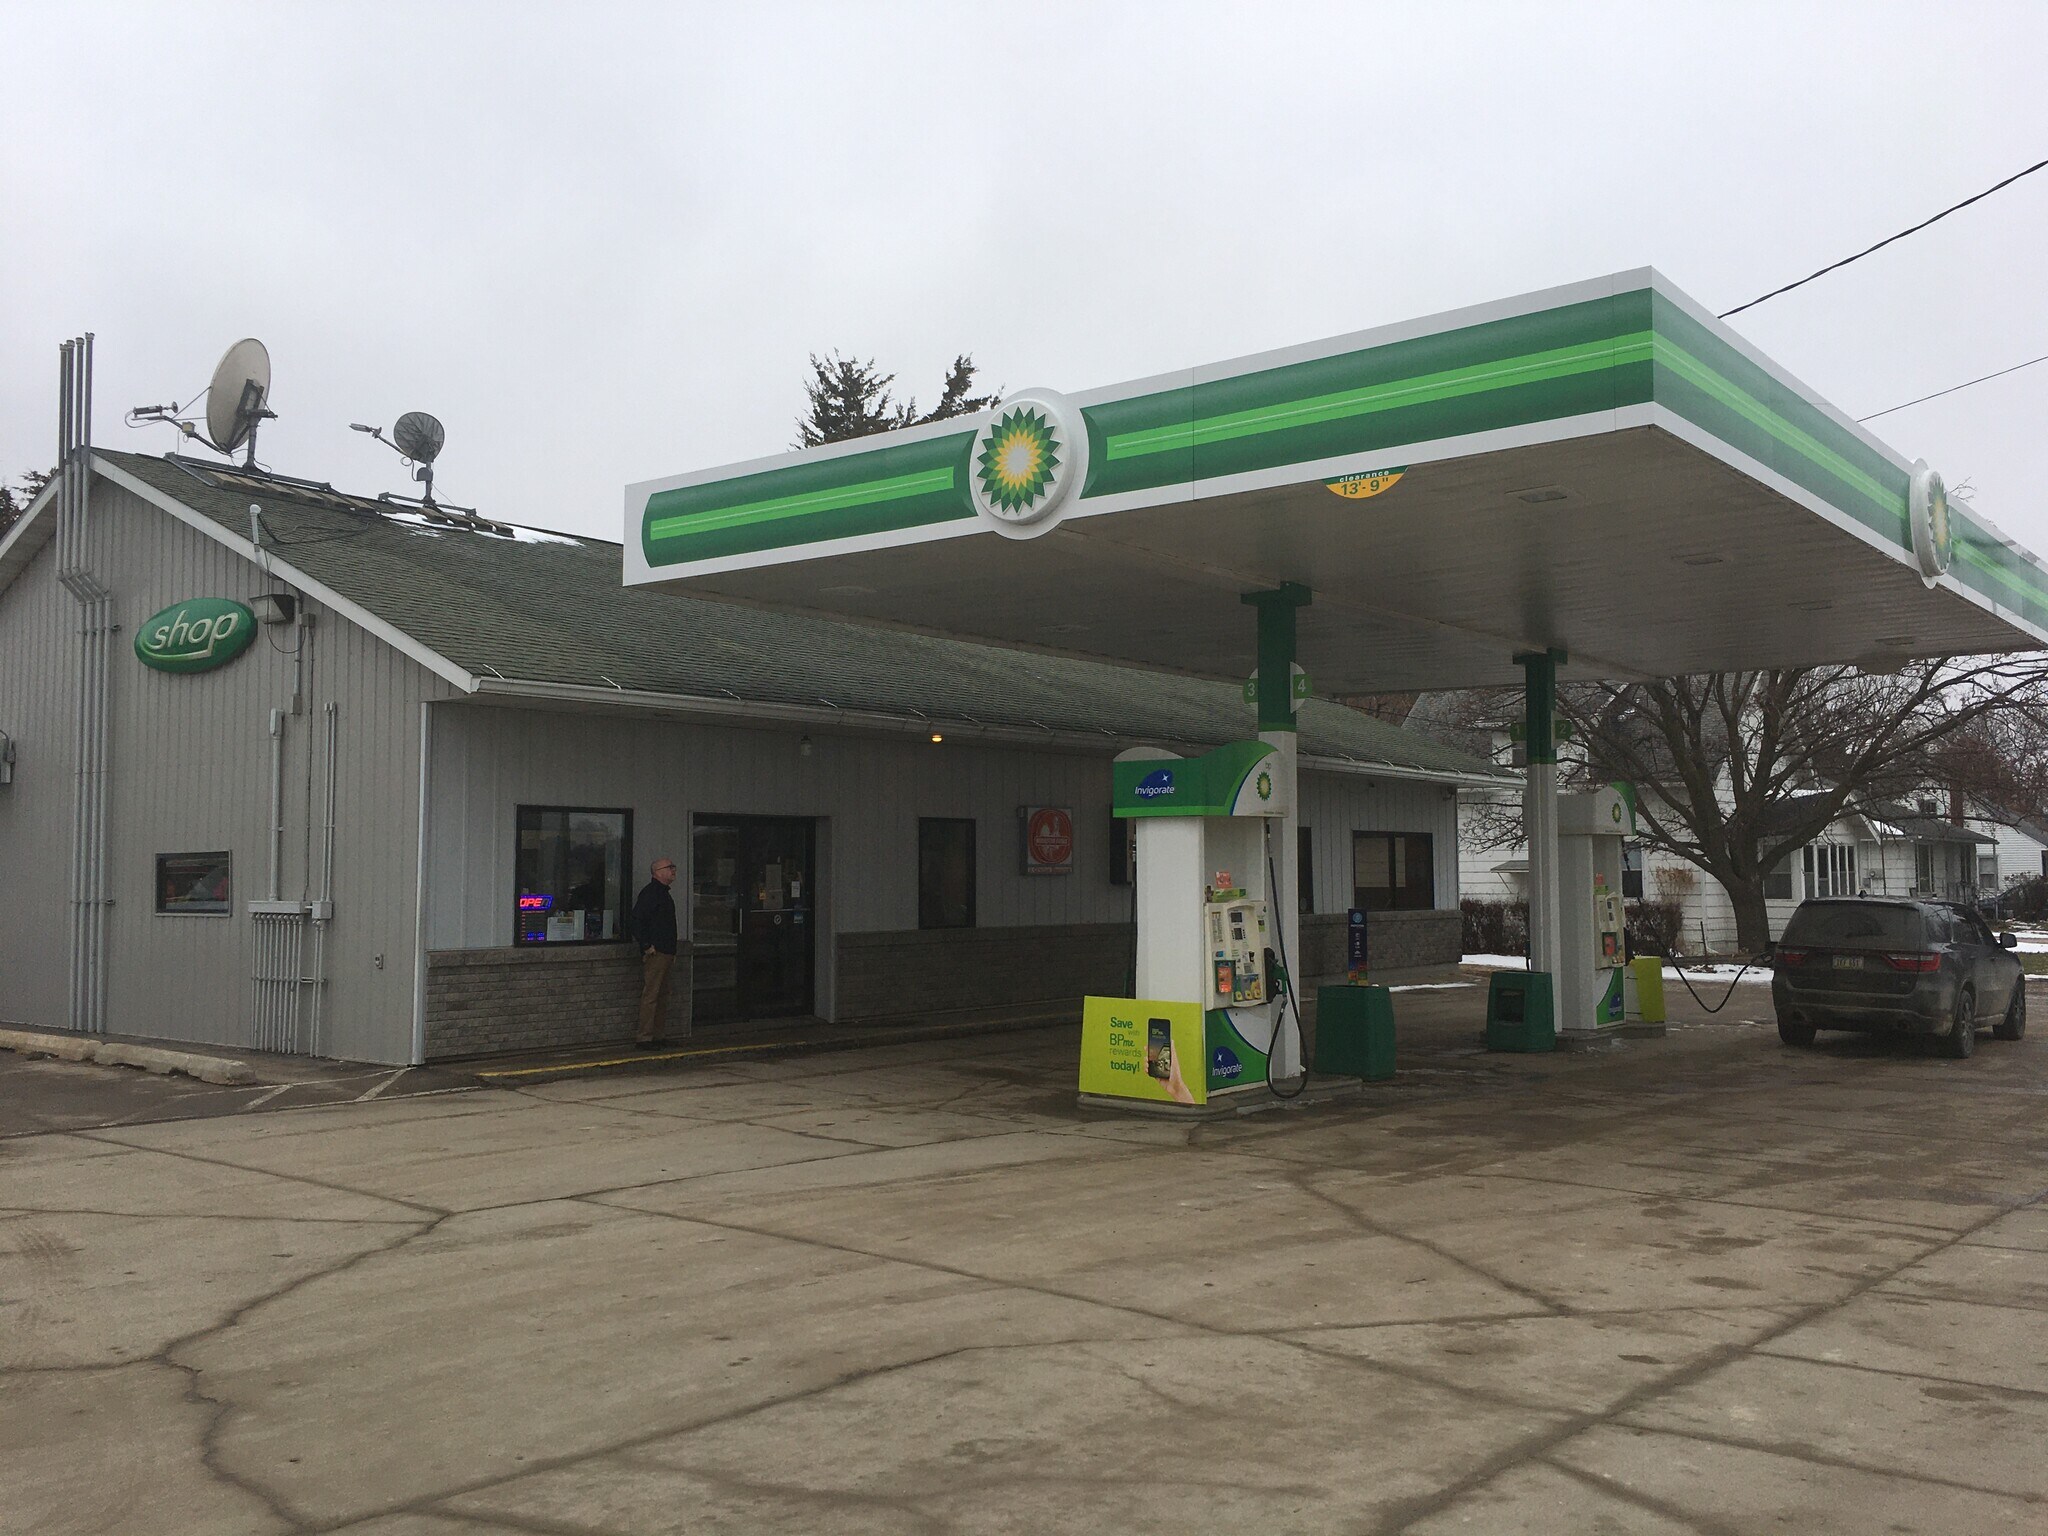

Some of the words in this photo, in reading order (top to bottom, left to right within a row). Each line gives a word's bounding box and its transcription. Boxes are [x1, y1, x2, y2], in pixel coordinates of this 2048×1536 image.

[1339, 470, 1390, 483] clearance
[149, 609, 239, 657] shop
[1247, 682, 1256, 697] 3
[1297, 678, 1307, 693] 4
[1134, 785, 1175, 797] Invigorate
[1110, 1016, 1133, 1029] Save
[1109, 1047, 1142, 1058] rewards
[1110, 1060, 1140, 1074] today!
[1212, 1063, 1243, 1077] Invigorate
